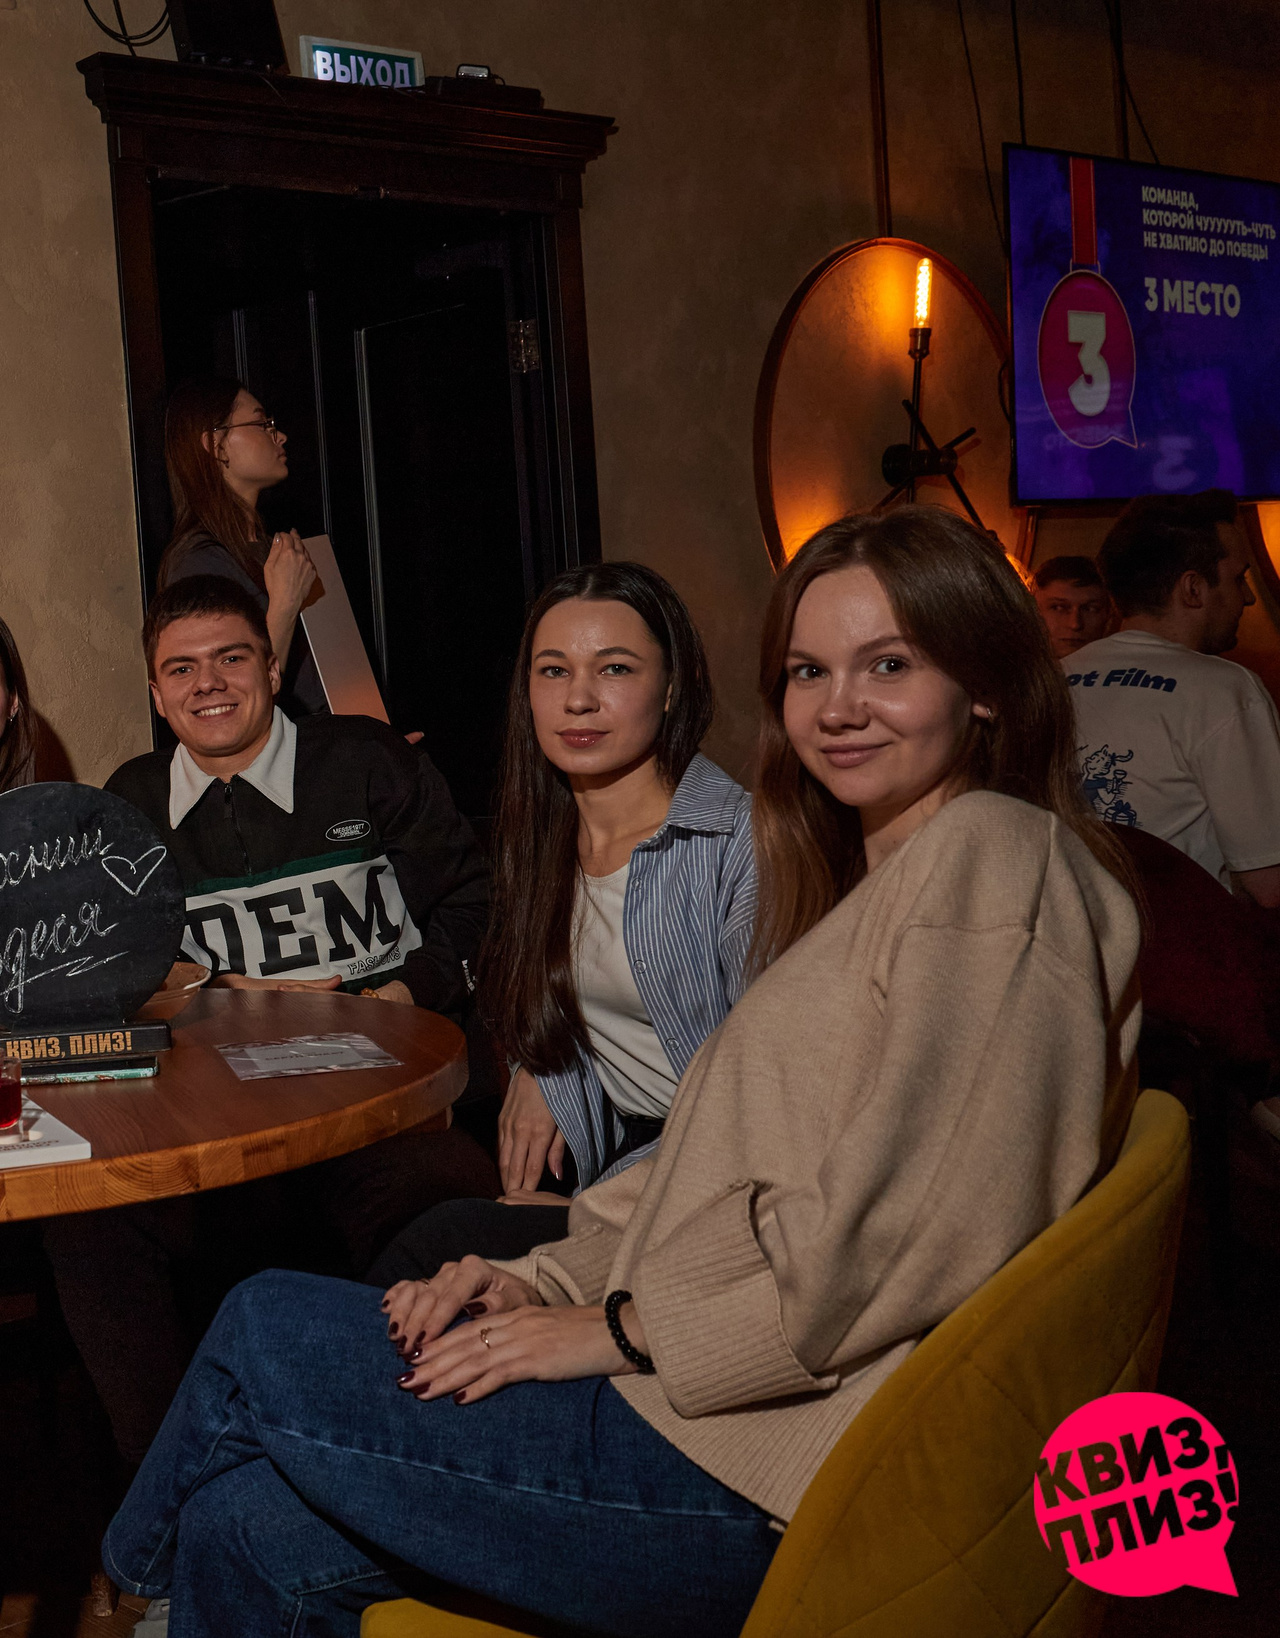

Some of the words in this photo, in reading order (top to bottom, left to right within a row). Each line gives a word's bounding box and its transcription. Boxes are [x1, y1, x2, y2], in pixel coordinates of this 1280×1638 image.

[315, 50, 412, 88] ВЫХОД
[1141, 185, 1199, 211] КОМАНДА,
[1142, 208, 1194, 230] КОТОРОЙ
[1143, 231, 1158, 248] НЕ
[1159, 233, 1208, 254] ХВАТИЛО
[1209, 238, 1225, 257] ДО
[1227, 240, 1269, 262] ПОБЕДЫ
[1144, 277, 1158, 312] 3
[1163, 278, 1241, 318] МЕСТО
[1067, 310, 1111, 417] 3
[1103, 668, 1178, 693] Film
[6, 1037, 66, 1059] КВИЗ,
[69, 1031, 132, 1056] ПЛИЗ!
